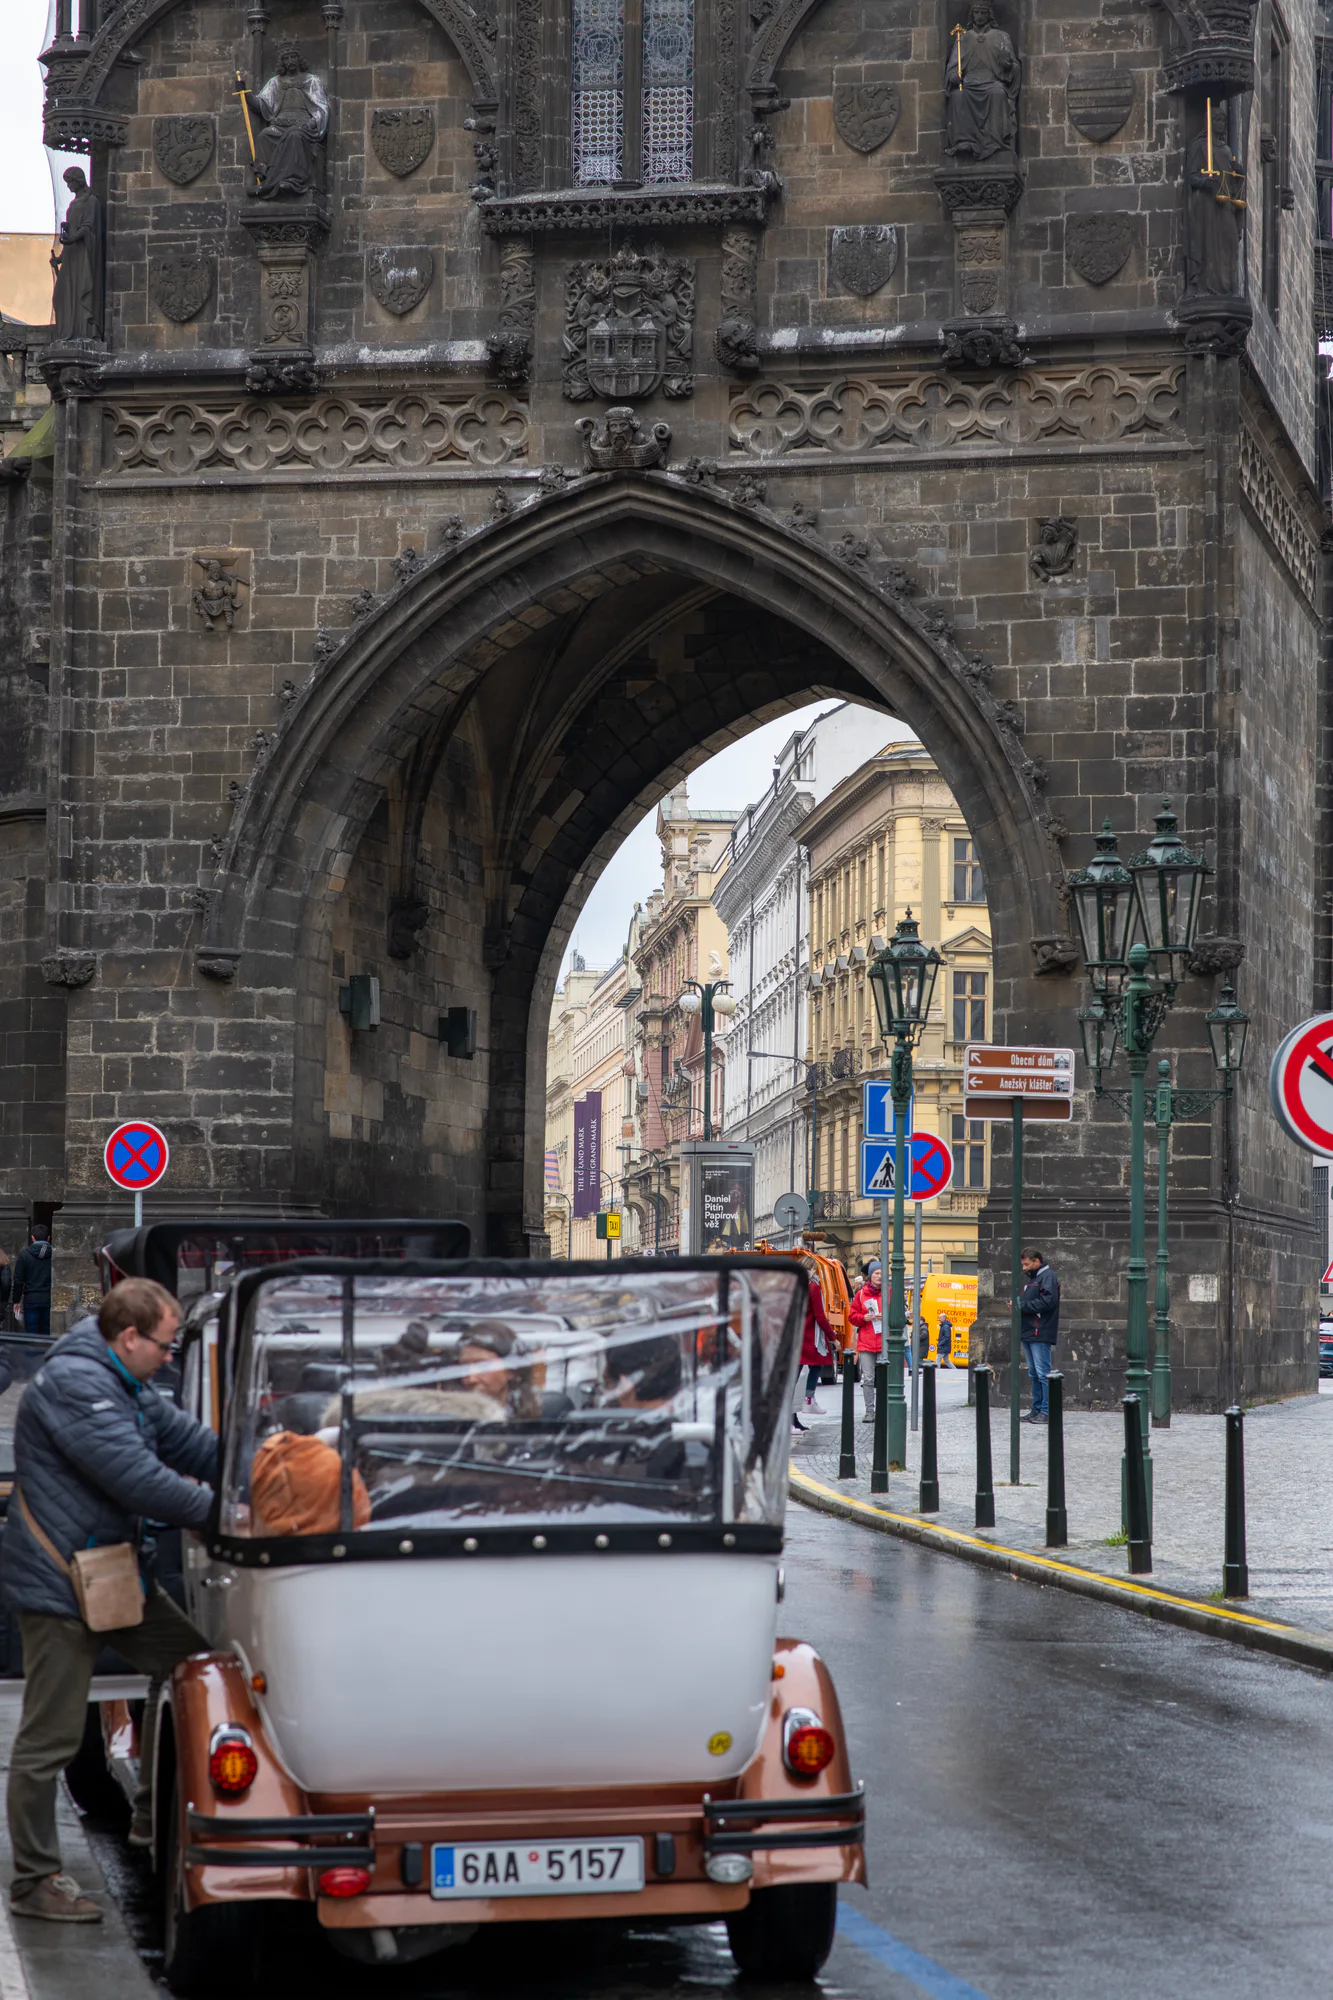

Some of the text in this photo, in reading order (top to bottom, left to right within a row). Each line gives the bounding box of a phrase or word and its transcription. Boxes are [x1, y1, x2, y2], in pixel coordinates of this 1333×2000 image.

[1011, 1054, 1053, 1067] Obecní dům
[1000, 1077, 1053, 1092] Anežský klášter
[589, 1118, 597, 1141] MARK
[577, 1127, 585, 1148] MARK
[589, 1142, 597, 1169] GRAND
[577, 1178, 585, 1193] THE
[704, 1194, 731, 1203] Daniel
[704, 1203, 724, 1212] Pitín
[704, 1211, 739, 1222] Papírová
[609, 1220, 618, 1230] TAXI
[704, 1219, 720, 1229] věž
[462, 1846, 625, 1884] 6AA 5157
[436, 1874, 452, 1886] CZ
